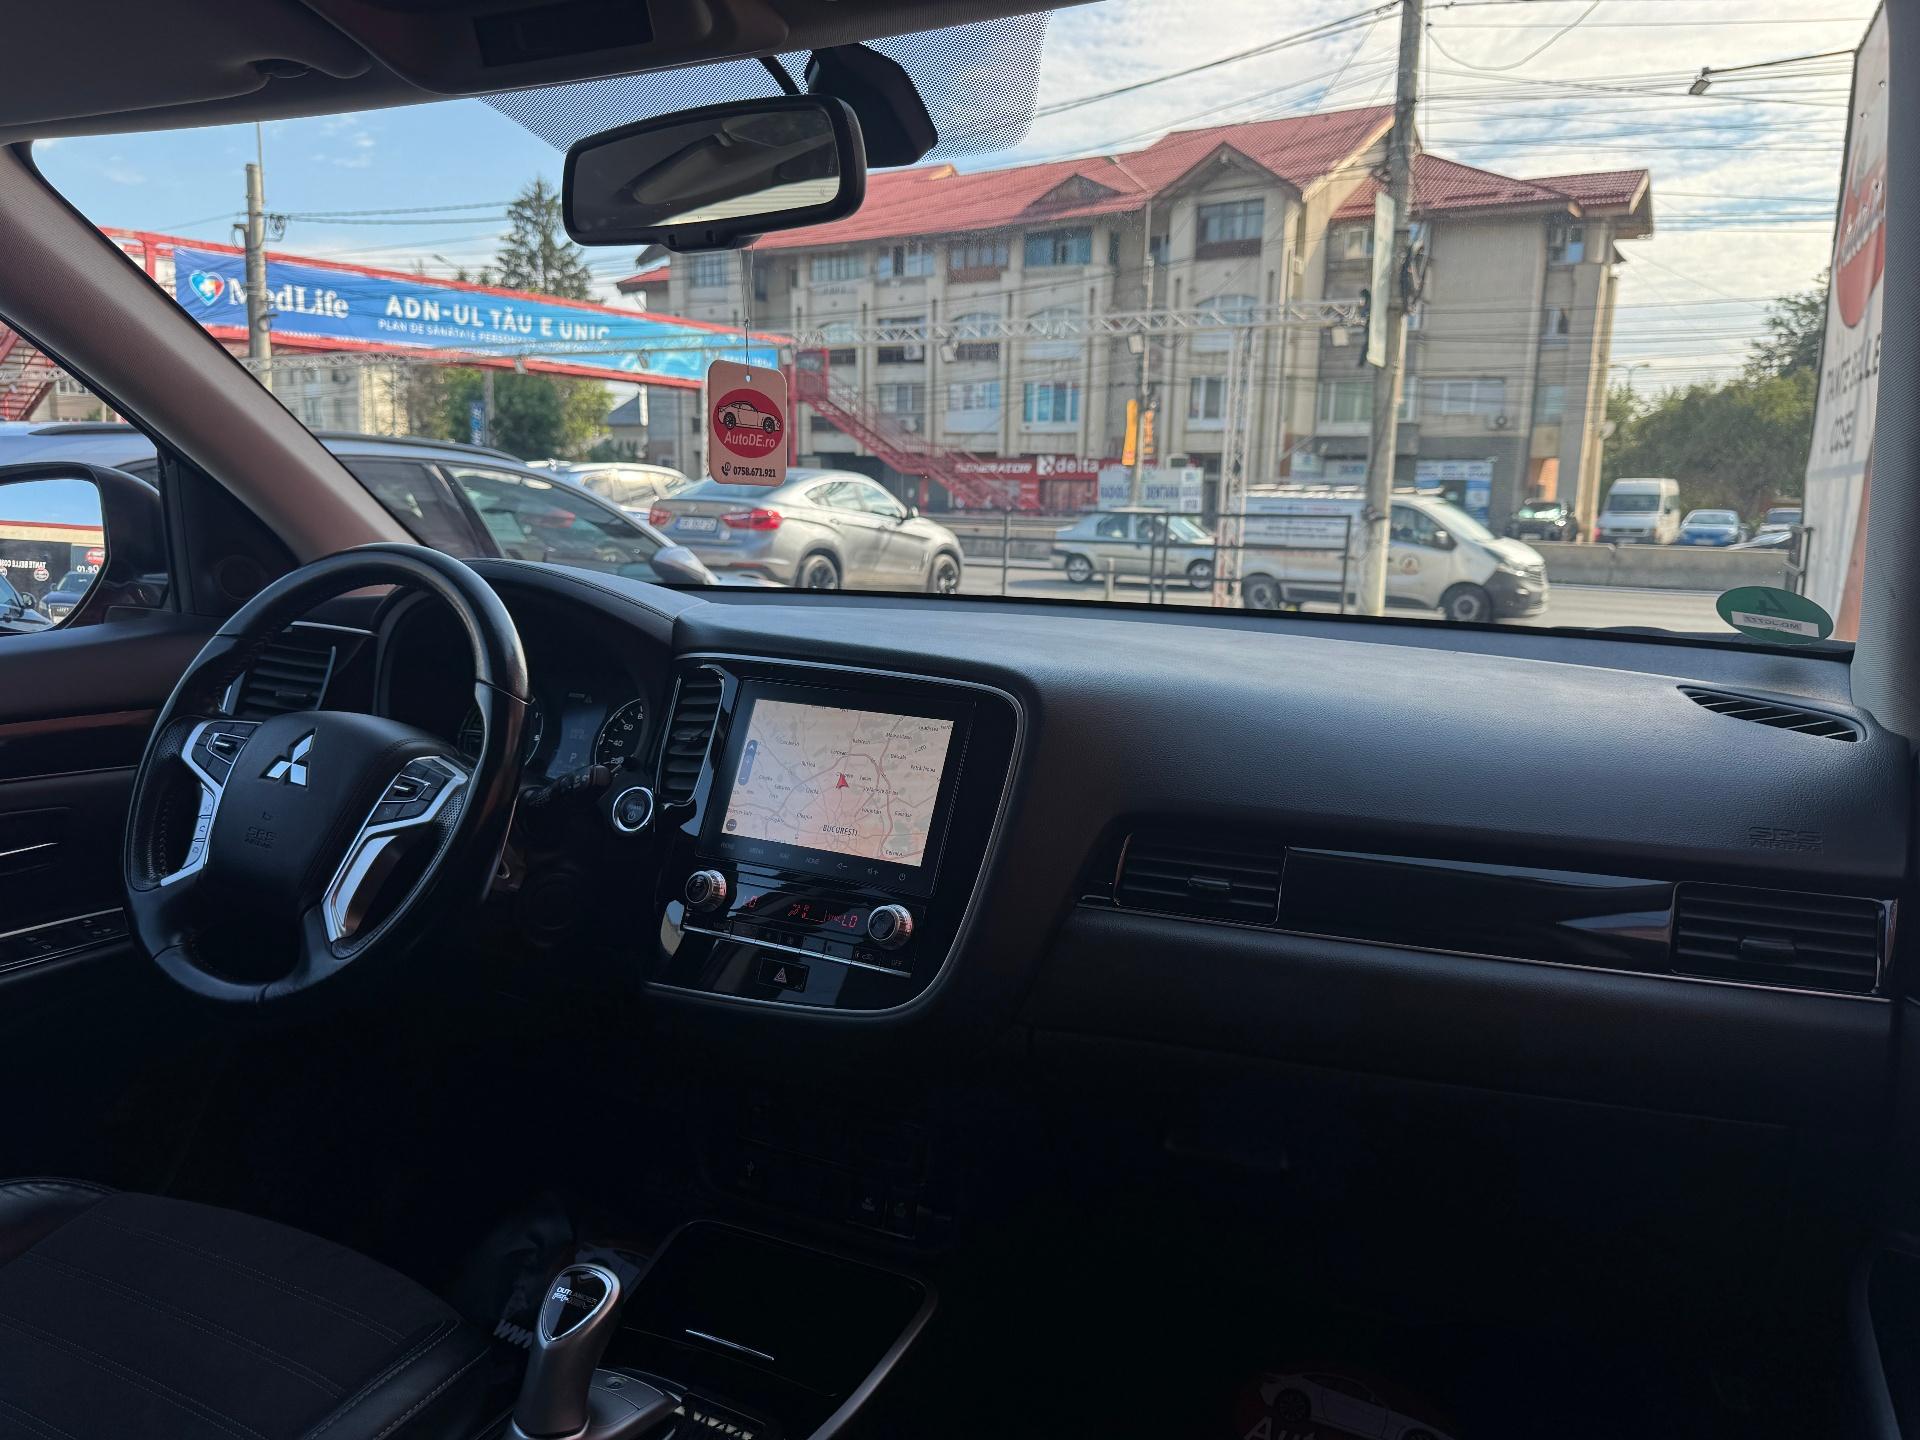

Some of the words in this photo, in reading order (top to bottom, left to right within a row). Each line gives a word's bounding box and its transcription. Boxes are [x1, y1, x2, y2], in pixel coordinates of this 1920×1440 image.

[385, 294, 485, 328] ADN-UL
[489, 306, 533, 334] TĂU
[540, 317, 554, 337] E
[378, 318, 408, 331] PLAN
[410, 323, 425, 335] DE
[723, 431, 776, 448] AutoDE.ro
[1055, 457, 1099, 474] delta
[623, 723, 634, 731] 60
[569, 752, 577, 763] P
